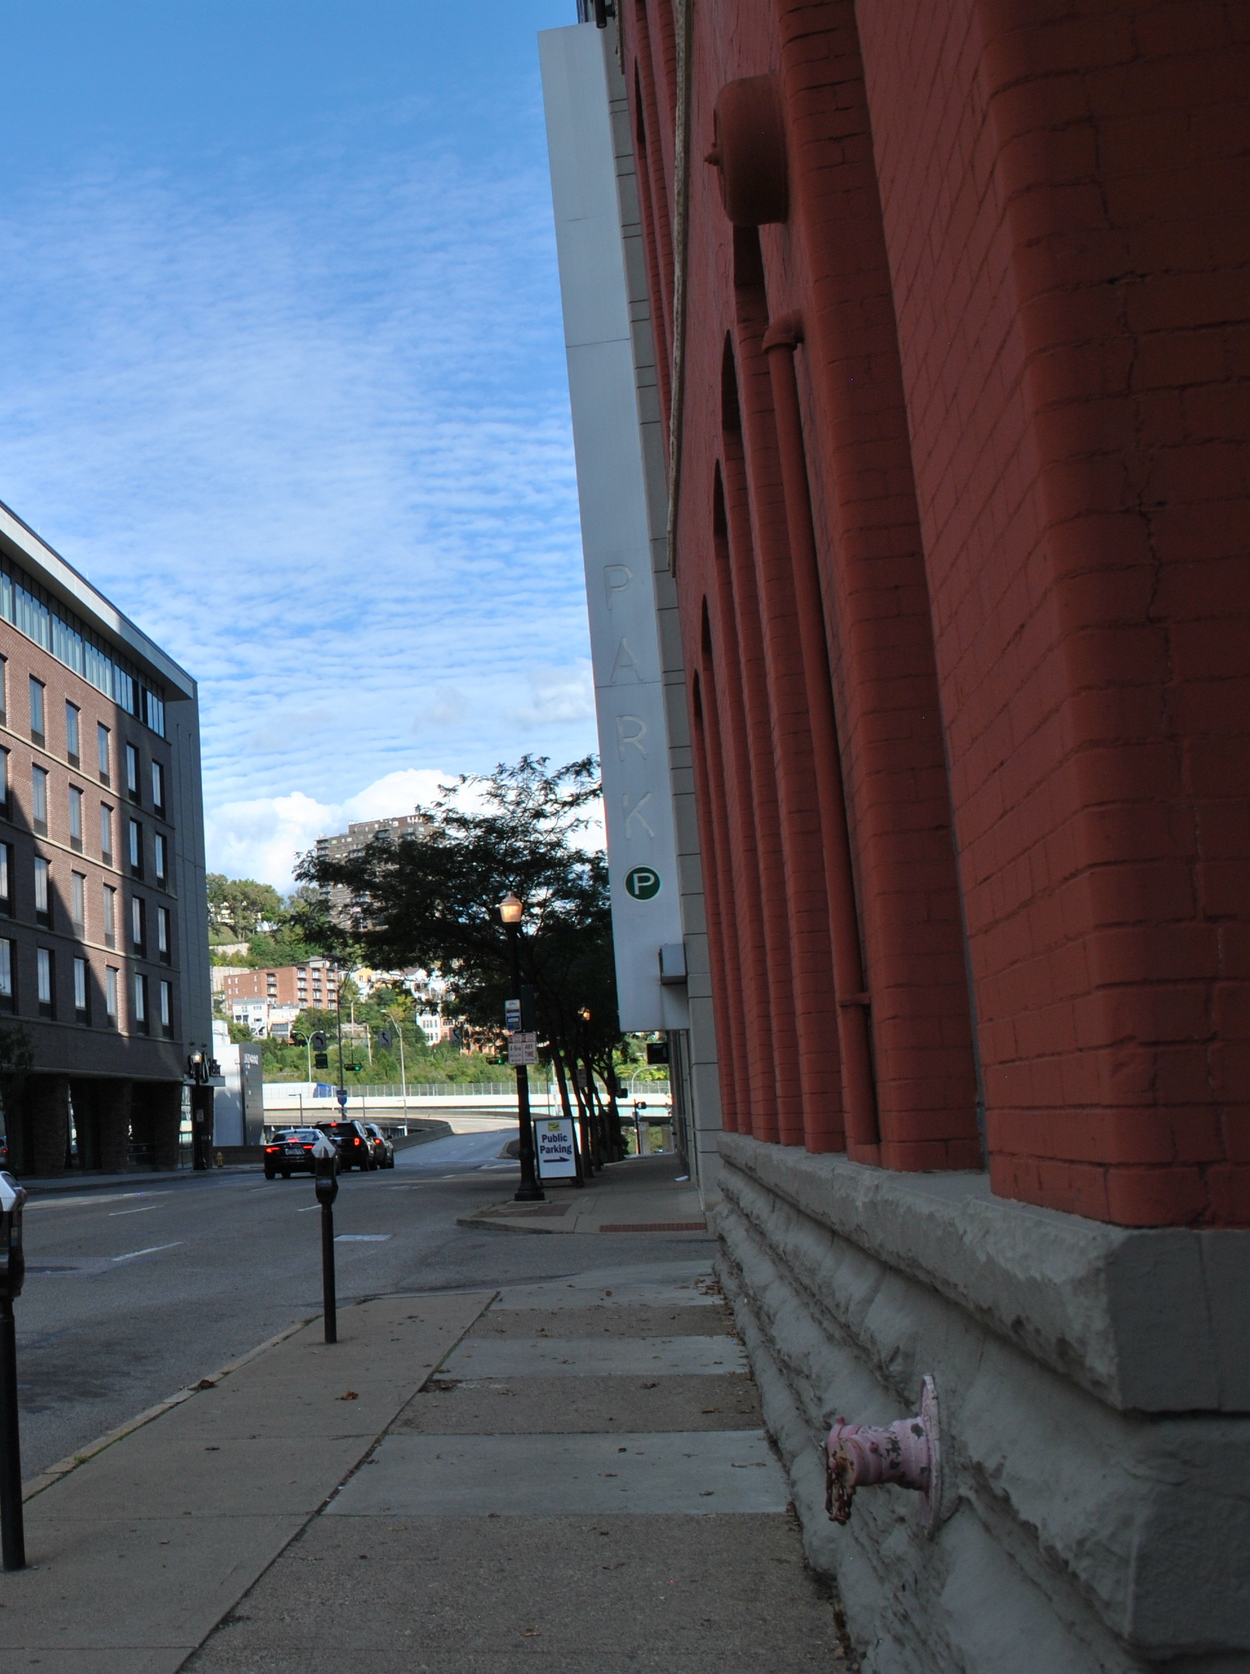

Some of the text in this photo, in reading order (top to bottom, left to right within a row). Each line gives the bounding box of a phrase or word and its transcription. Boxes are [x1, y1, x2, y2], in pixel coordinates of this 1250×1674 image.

[633, 872, 657, 895] P
[541, 1133, 568, 1143] Public
[540, 1144, 572, 1155] Parking
